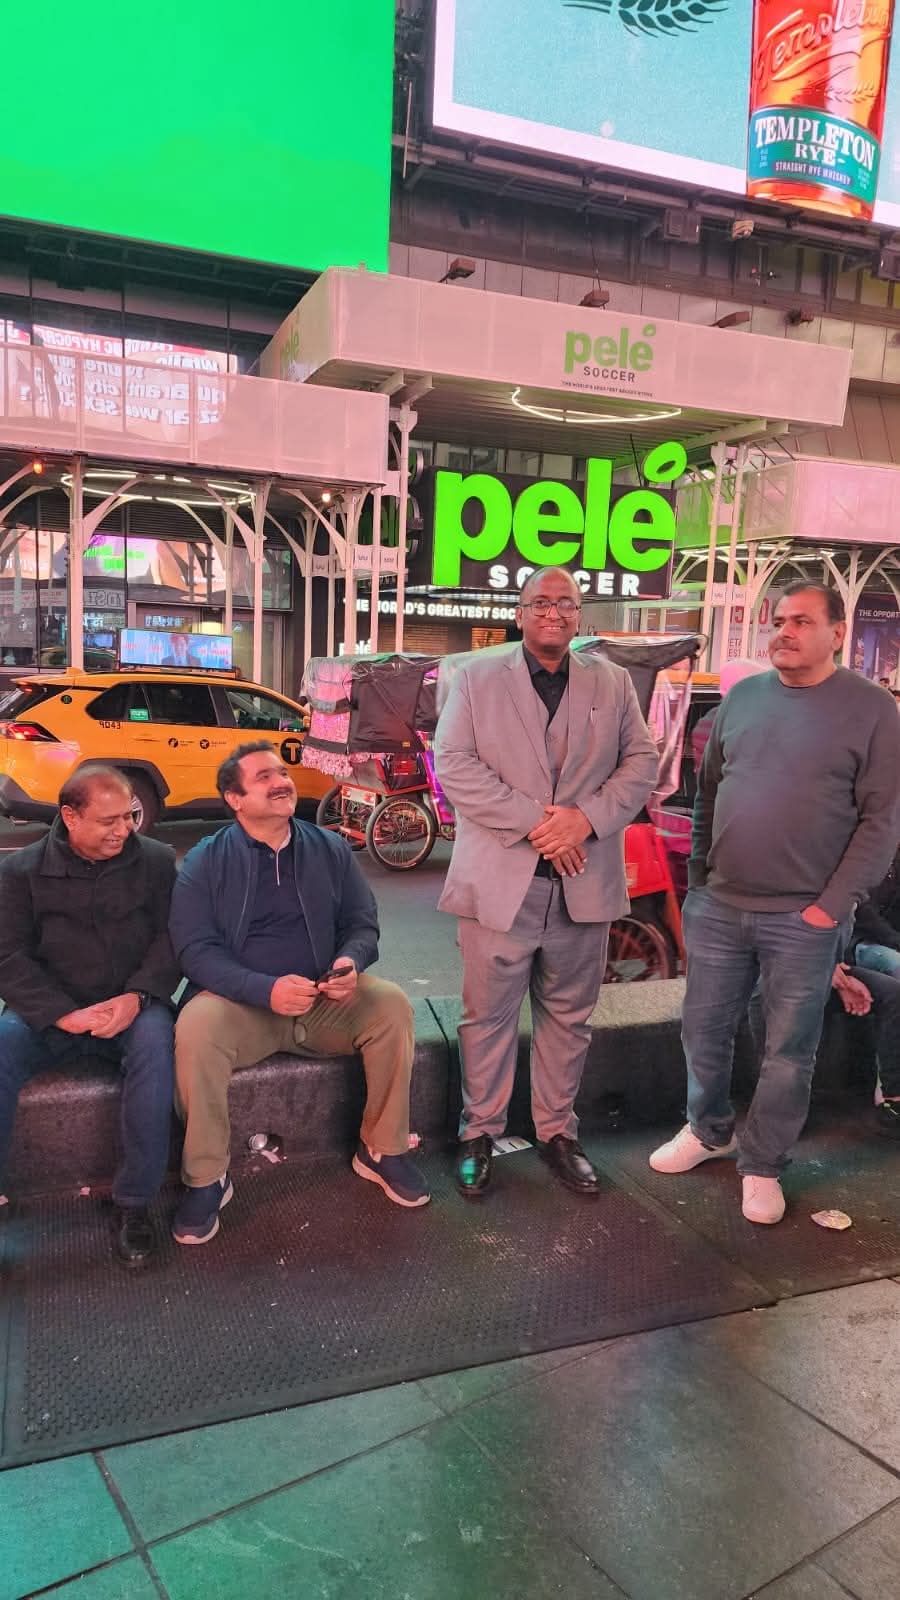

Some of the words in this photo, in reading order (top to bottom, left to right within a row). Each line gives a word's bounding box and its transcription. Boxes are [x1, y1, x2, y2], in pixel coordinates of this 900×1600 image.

[755, 115, 876, 172] TEMPLETON
[795, 142, 837, 167] RYE
[775, 161, 807, 173] STRAIGHT
[808, 164, 821, 177] RYE
[822, 168, 852, 185] WHISKEY
[583, 365, 636, 382] SOCCER
[432, 441, 687, 587] pelé
[488, 564, 640, 596] SOCER
[427, 603, 491, 619] GREATEST
[859, 609, 872, 617] THE
[286, 742, 301, 762] T
